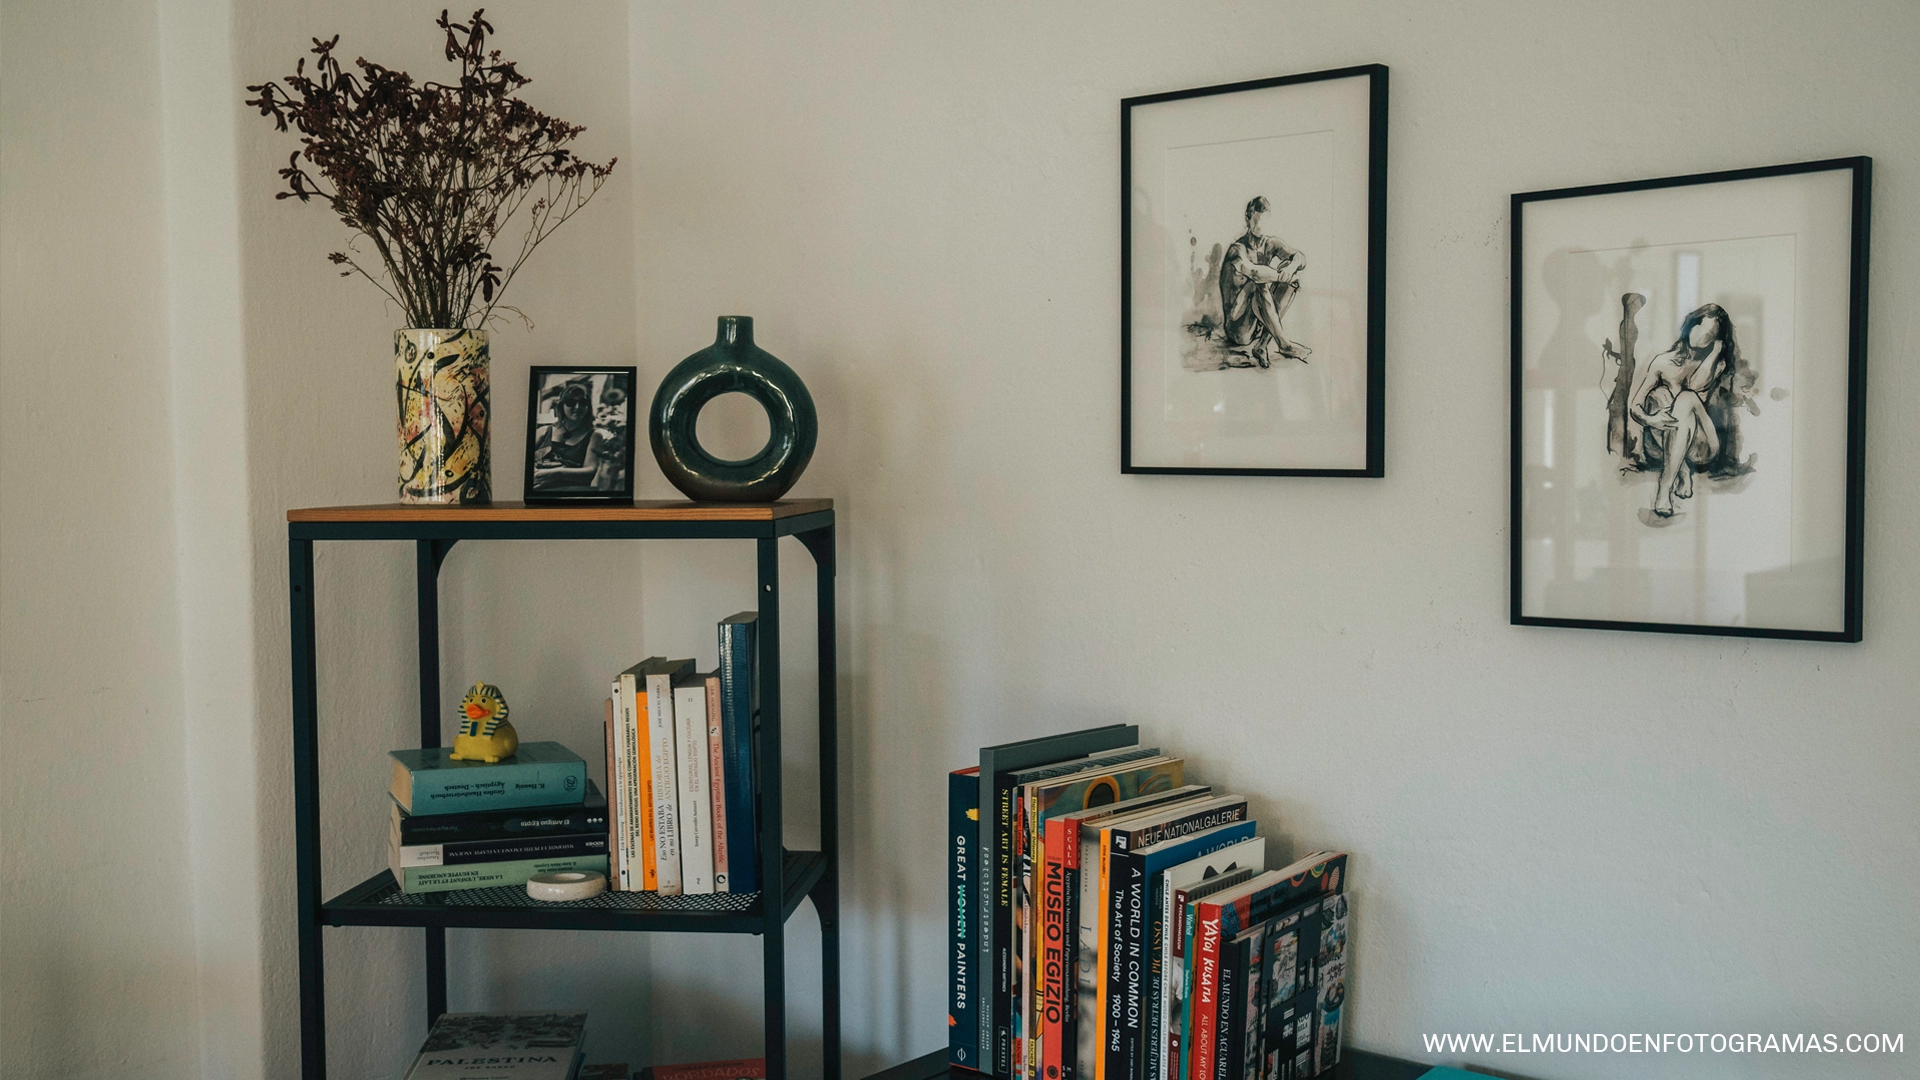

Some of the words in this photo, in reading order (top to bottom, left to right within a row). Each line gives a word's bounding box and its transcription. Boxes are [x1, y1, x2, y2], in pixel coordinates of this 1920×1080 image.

[430, 790, 482, 799] Handwörterbuch
[475, 781, 505, 789] Ägyptisch
[656, 765, 664, 800] HISTORIA
[713, 779, 722, 803] Egyptian
[657, 804, 666, 834] ESTABA
[1138, 830, 1161, 848] NEUE
[1164, 808, 1240, 840] NATIONALGALERIE
[659, 836, 666, 848] NO
[668, 838, 674, 846] mi
[957, 835, 966, 881] GREAT
[1001, 854, 1008, 864] IS
[1131, 867, 1141, 878] A
[1046, 861, 1061, 942] MUSEO
[1114, 889, 1124, 903] The
[957, 884, 966, 939] WOMEN
[1114, 911, 1124, 927] Art
[1129, 883, 1140, 938] WORLD
[1114, 929, 1123, 941] of
[1152, 920, 1162, 974] PICASSO
[1129, 941, 1140, 956] IN
[1112, 942, 1123, 982] Society
[957, 942, 966, 1009] PAINTERS
[1046, 947, 1061, 1024] EGIZIO
[1152, 976, 1160, 989] DE
[1222, 969, 1231, 980] EL
[1112, 994, 1121, 1017] 1900
[1127, 960, 1139, 1028] COMMON
[1221, 982, 1231, 1019] MUNDO
[1151, 990, 1160, 1027] DETRÁS
[1221, 1020, 1229, 1033] EN
[1111, 1028, 1120, 1052] 1945
[1150, 1028, 1159, 1071] MUJERES
[427, 1057, 557, 1065] PALESTINA
[1200, 1056, 1207, 1069] MY
[1218, 1034, 1228, 1080] ACUAREL
